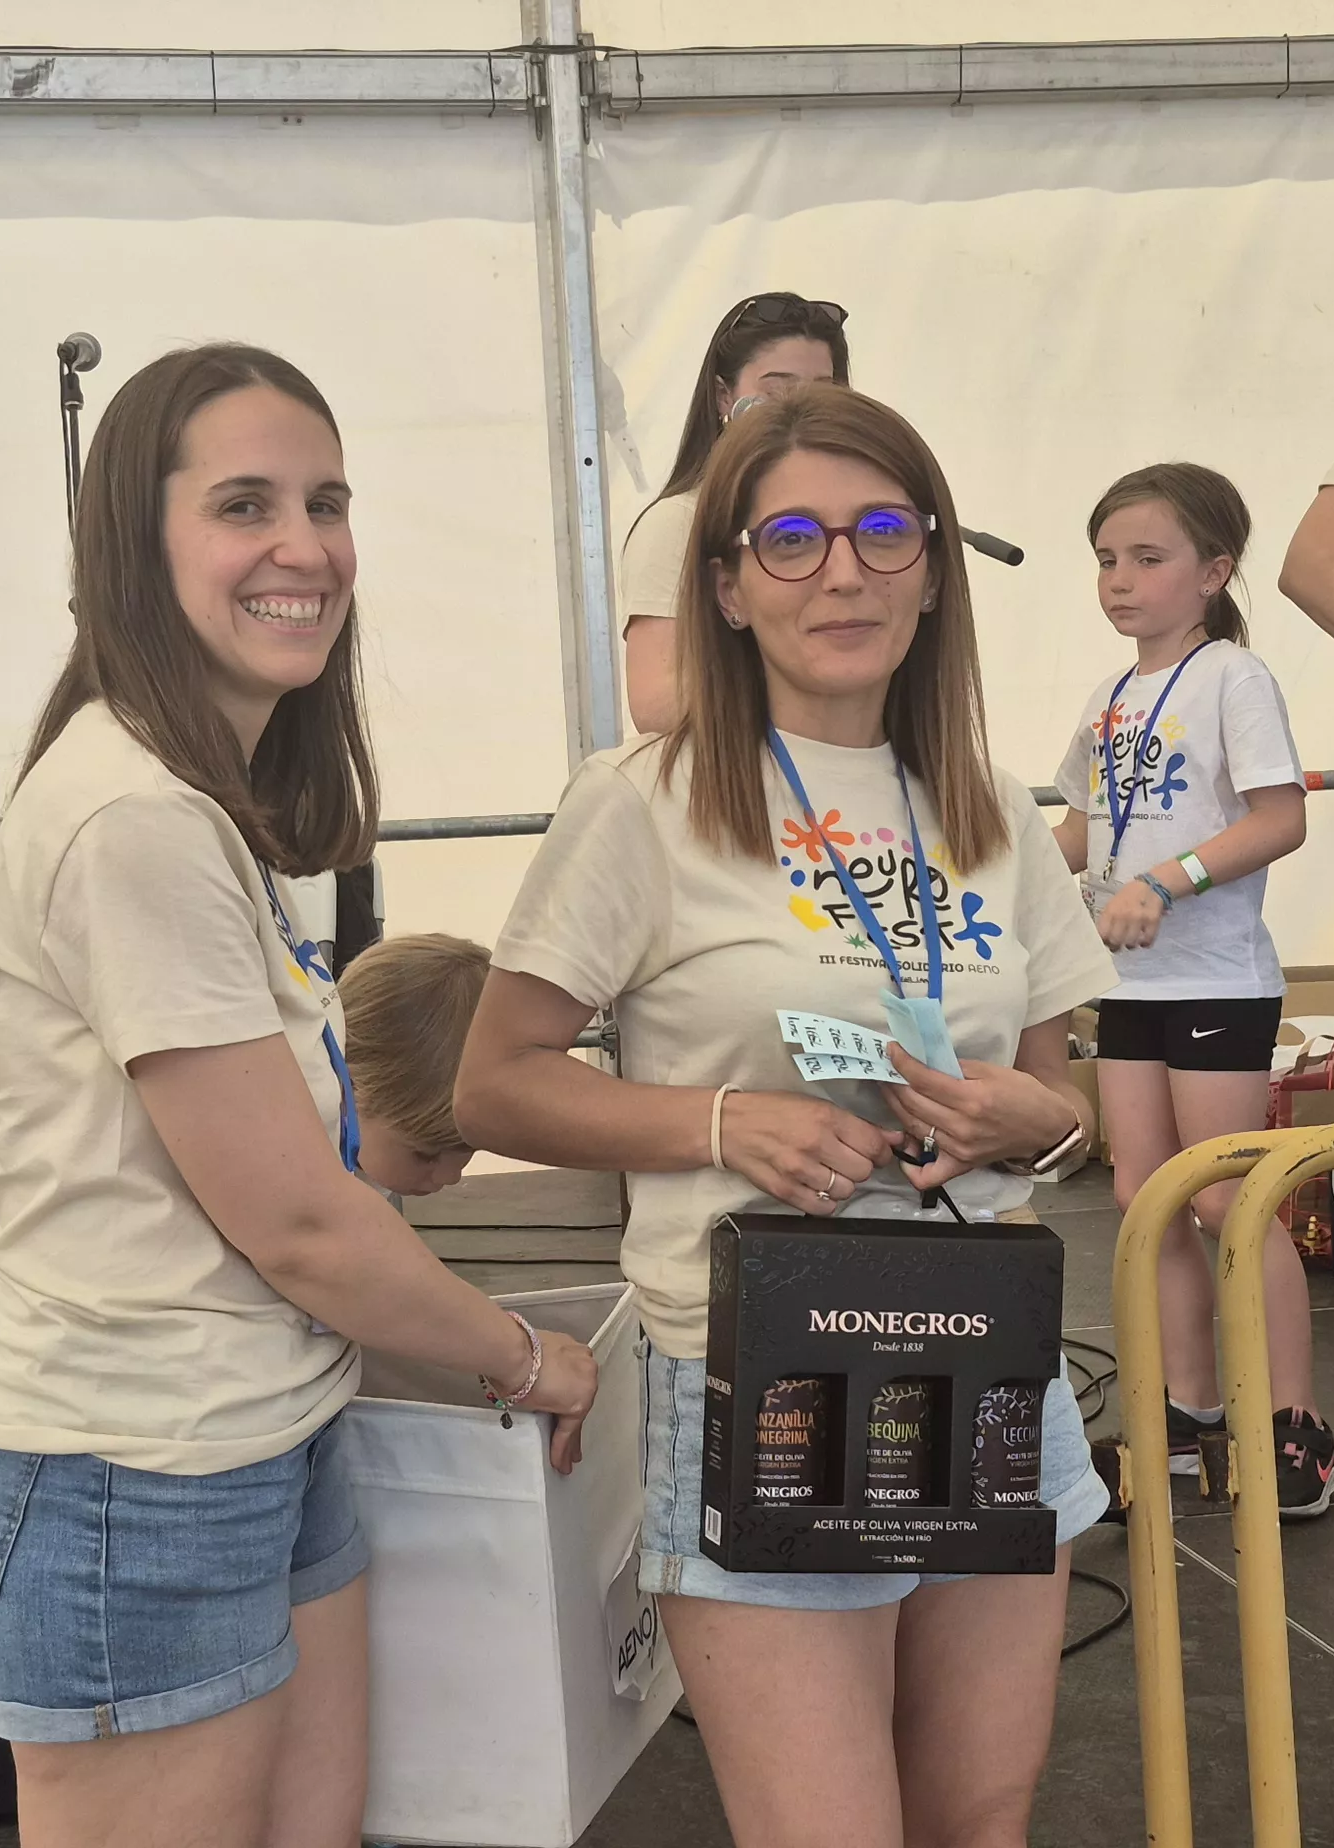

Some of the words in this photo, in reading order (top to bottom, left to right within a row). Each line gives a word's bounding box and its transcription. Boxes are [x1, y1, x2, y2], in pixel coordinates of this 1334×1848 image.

[819, 955, 836, 964] III
[840, 956, 892, 970] FESTIVA
[897, 960, 964, 973] SOLIDRIO
[808, 1310, 988, 1337] MONEGROS
[873, 1342, 900, 1352] Desde
[903, 1342, 924, 1352] 1838
[813, 1520, 850, 1530] ACEITE
[853, 1520, 866, 1530] DE
[868, 1520, 901, 1530] OLIVA
[904, 1521, 944, 1530] VIRGEN
[946, 1521, 978, 1531] EXTRA
